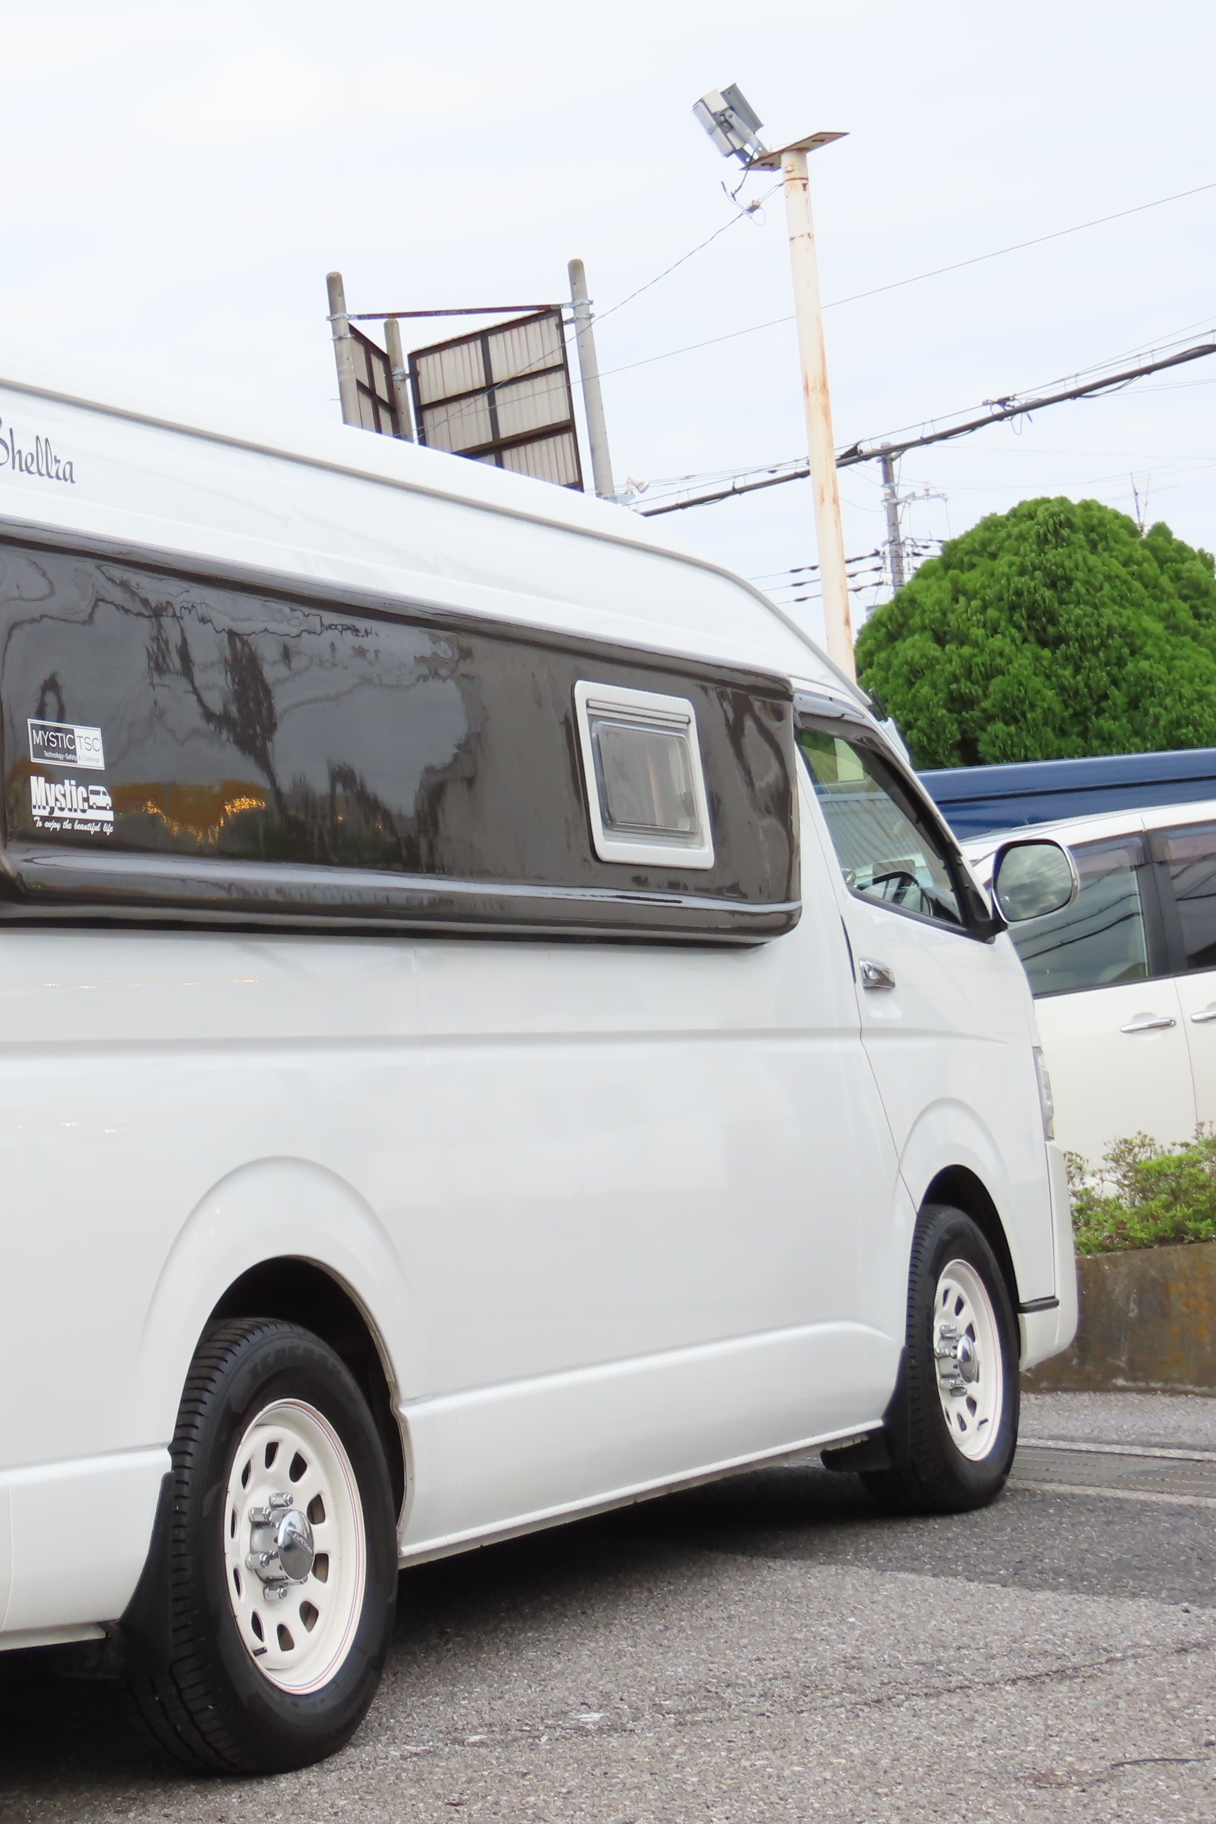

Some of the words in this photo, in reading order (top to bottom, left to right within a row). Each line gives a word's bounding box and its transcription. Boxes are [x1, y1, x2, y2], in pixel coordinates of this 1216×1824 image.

[32, 729, 76, 750] MYSTIC
[76, 735, 101, 752] TSC
[30, 775, 88, 816] Mystic
[44, 820, 61, 832] enjoy
[62, 819, 72, 830] the
[74, 820, 101, 835] beautiful
[102, 823, 114, 836] life
